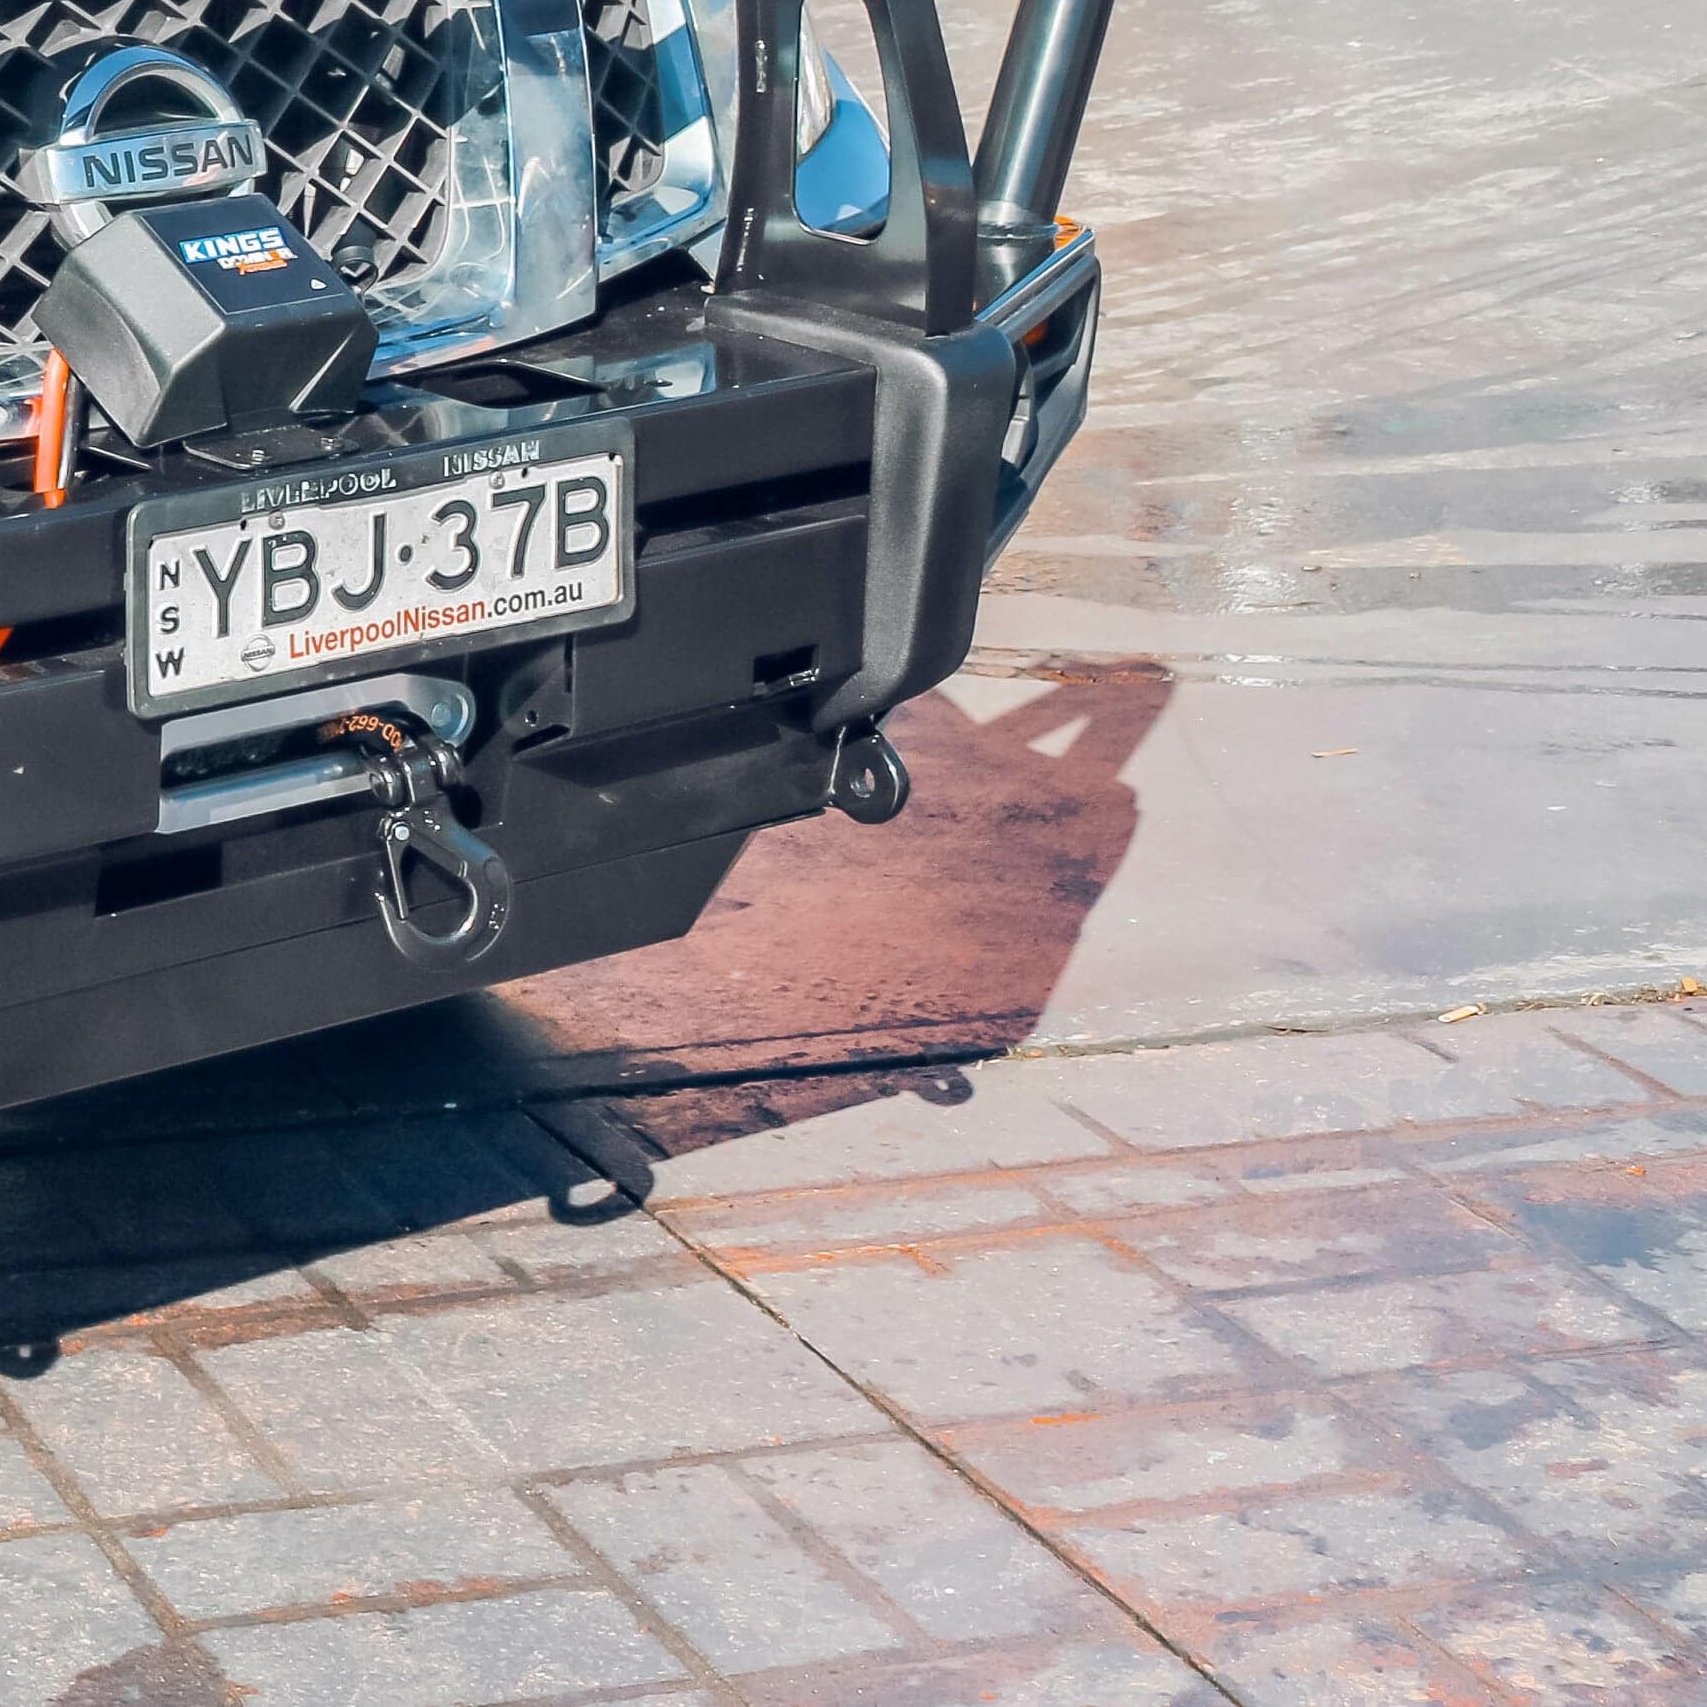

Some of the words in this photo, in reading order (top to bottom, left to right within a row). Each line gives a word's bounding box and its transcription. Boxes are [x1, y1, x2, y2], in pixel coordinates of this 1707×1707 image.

[82, 133, 256, 188] NISSAN
[184, 226, 285, 262] KINGS
[443, 440, 541, 477] NISSAN
[288, 581, 584, 661] LiverpoolNissan.com.au
